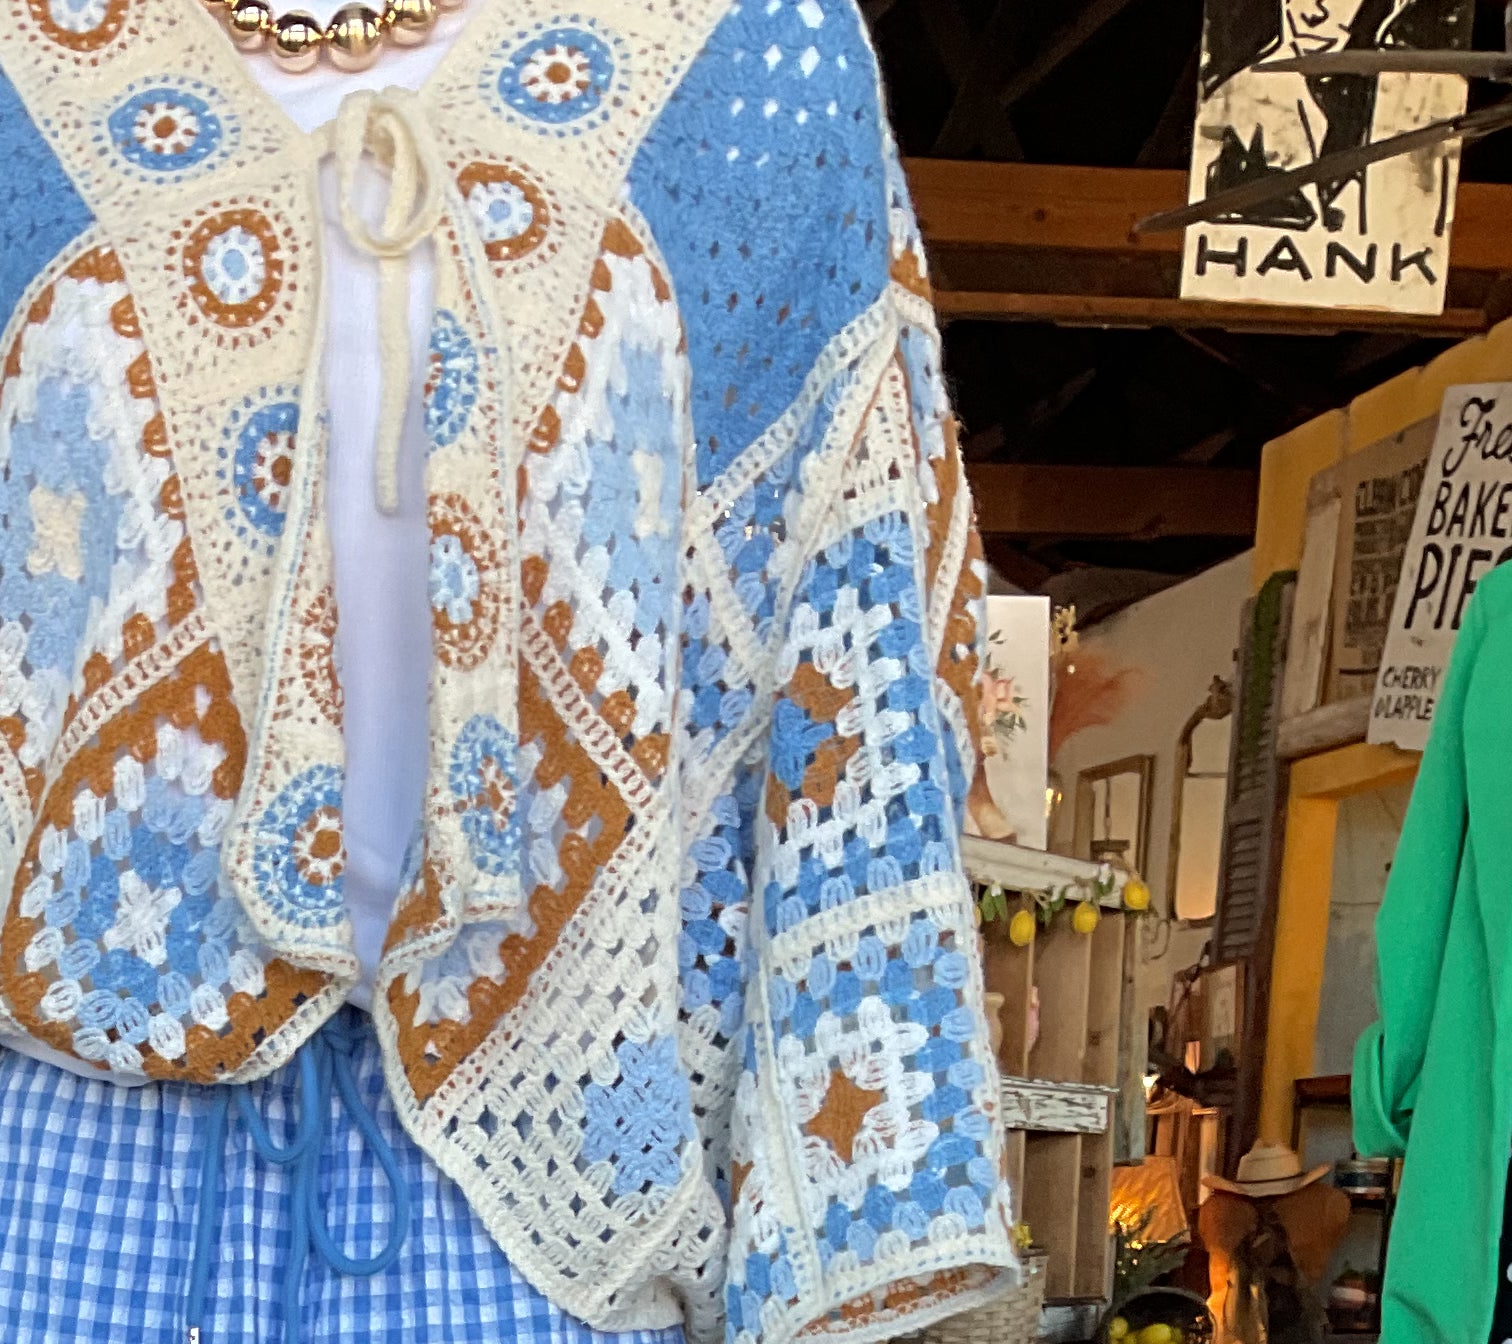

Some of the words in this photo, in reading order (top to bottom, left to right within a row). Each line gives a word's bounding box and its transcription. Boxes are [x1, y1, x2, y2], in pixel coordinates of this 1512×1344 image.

[1195, 233, 1438, 286] HANK
[1442, 397, 1512, 478] Fre
[1426, 478, 1512, 539] BAKE
[1404, 542, 1512, 631] PIE
[1382, 664, 1442, 692] CHERRY
